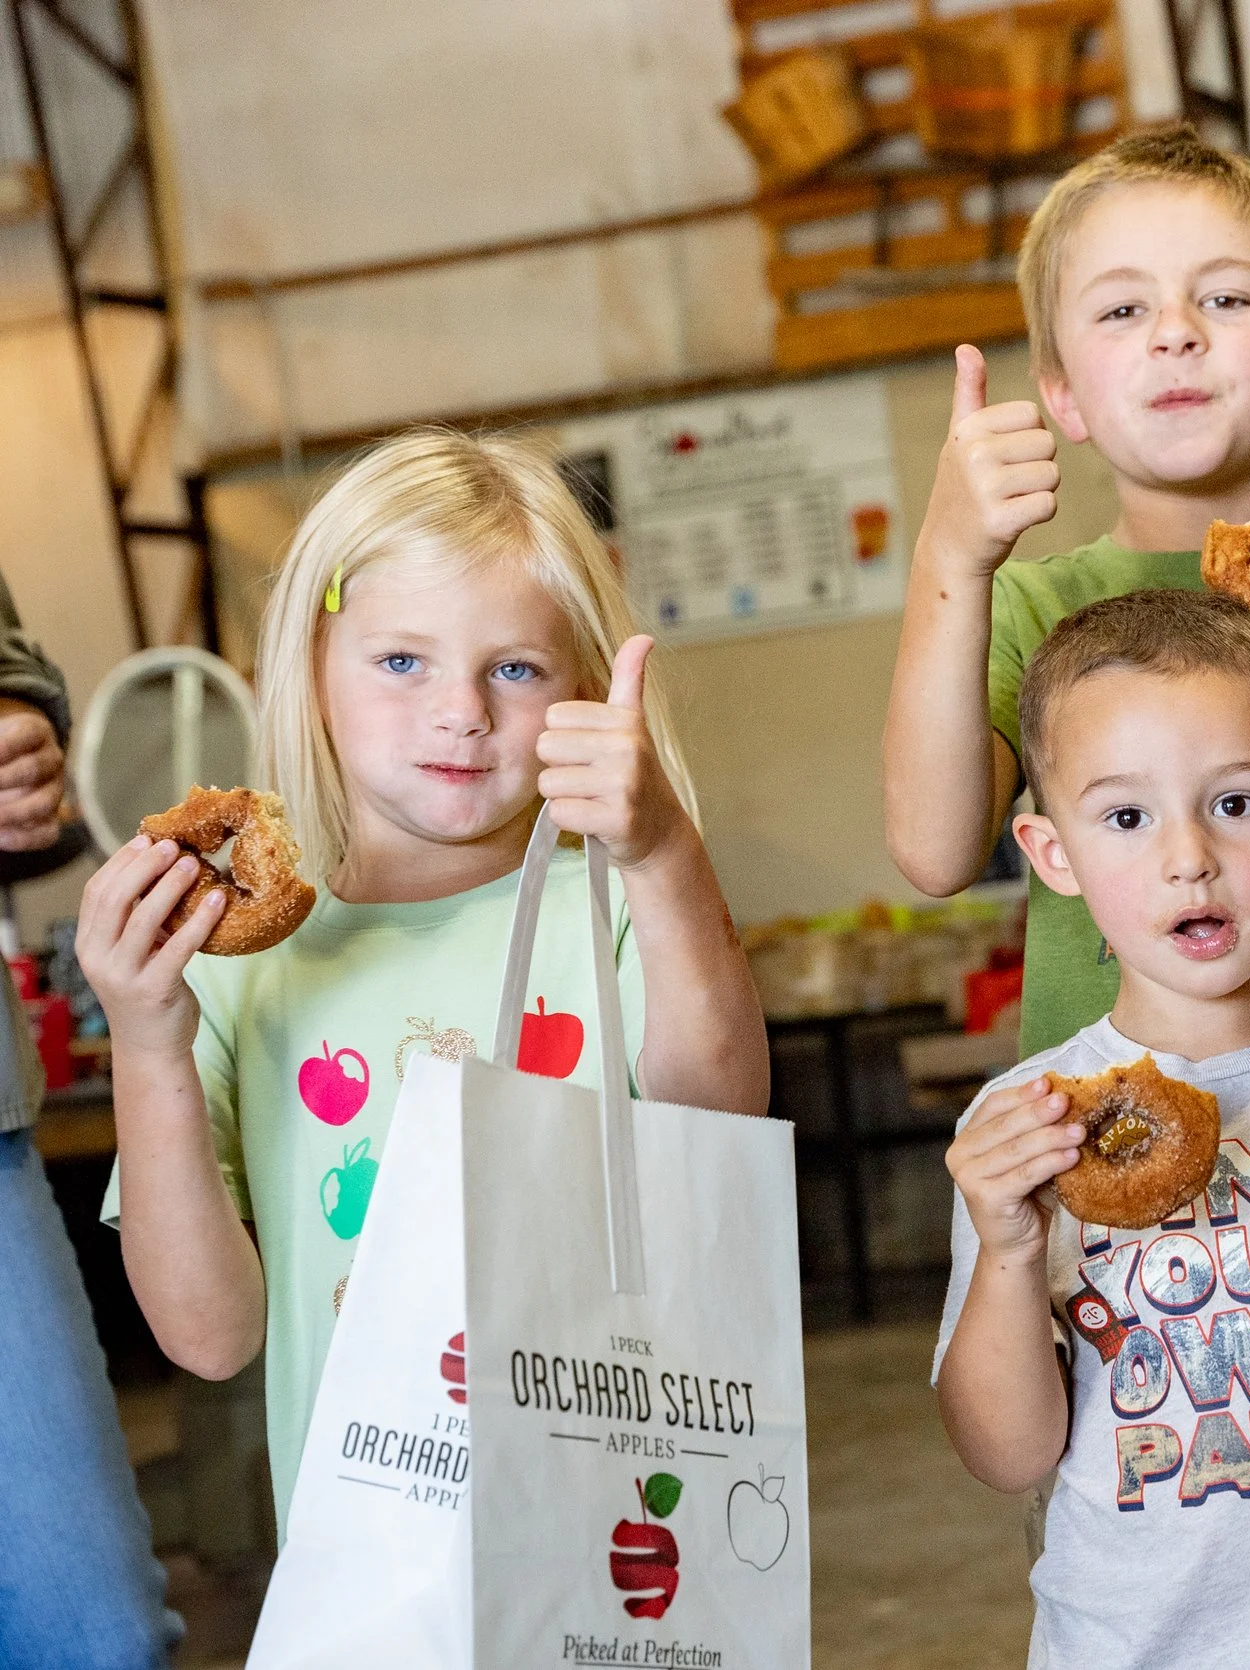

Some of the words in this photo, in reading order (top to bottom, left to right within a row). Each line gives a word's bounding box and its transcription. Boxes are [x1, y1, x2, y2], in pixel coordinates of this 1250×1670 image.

[1099, 1118, 1147, 1154] XPLOR
[619, 1336, 653, 1357] PECK
[512, 1350, 652, 1423] ORCHARD
[661, 1372, 754, 1437] SELECT
[445, 1415, 470, 1438] PE
[341, 1421, 469, 1484] ORCHARD
[606, 1431, 676, 1460] APPLES
[563, 1634, 619, 1661] Picked
[621, 1641, 639, 1663] at
[644, 1639, 722, 1669] Perfection
